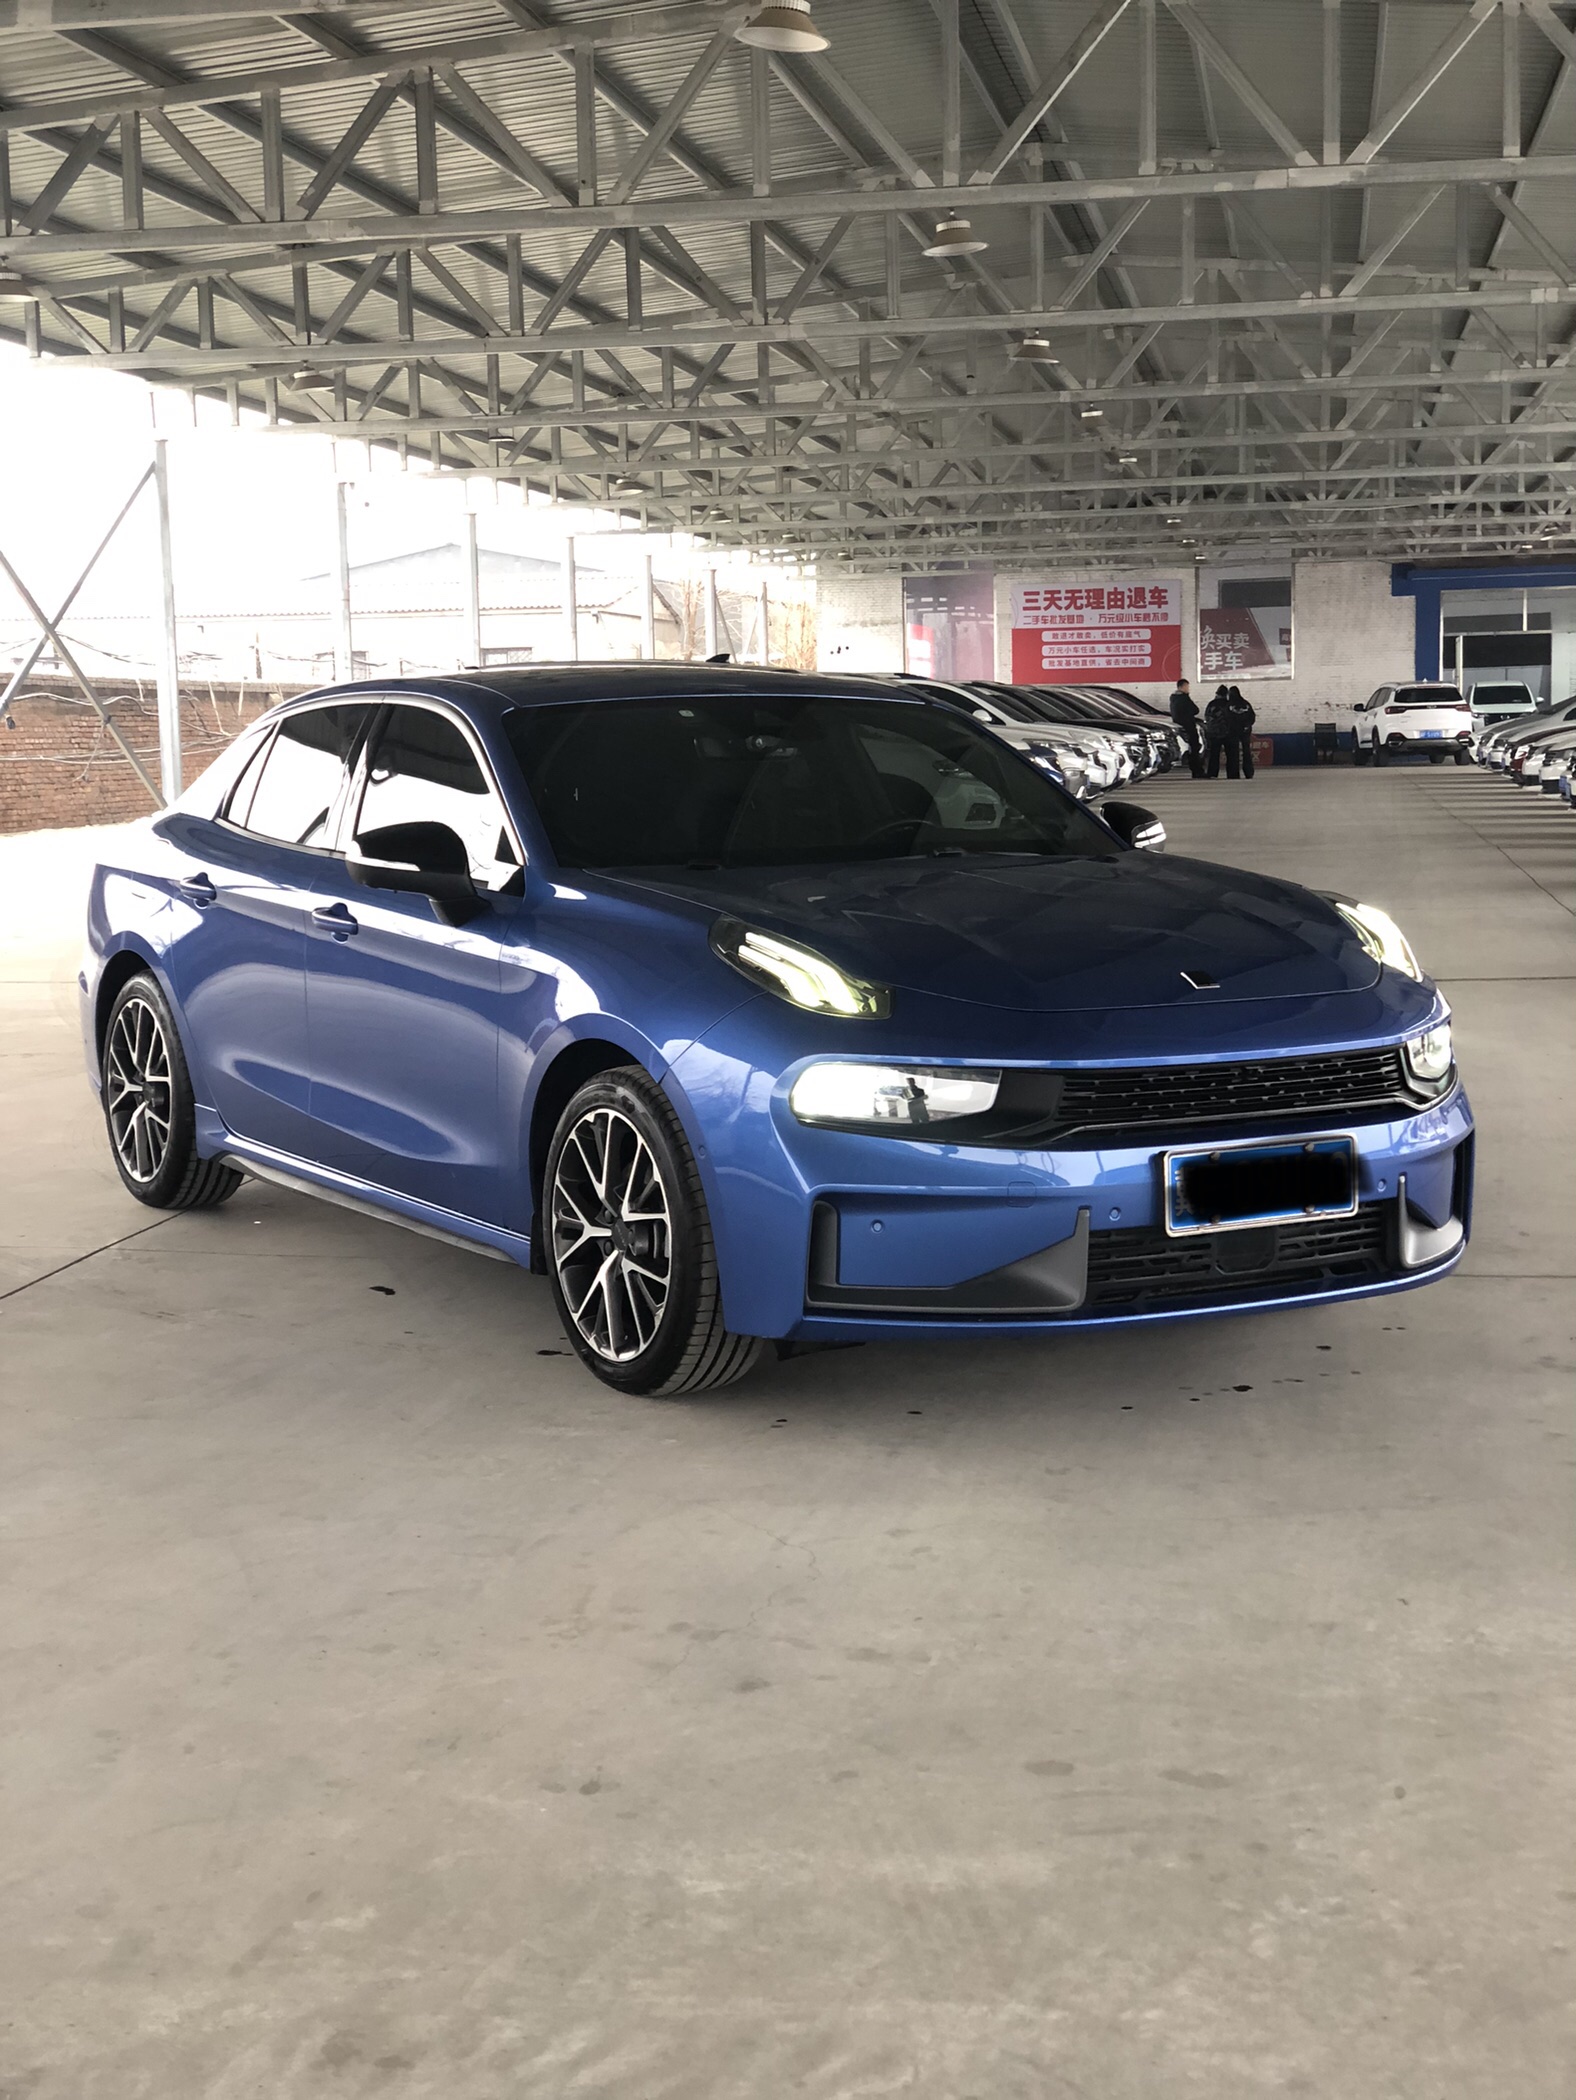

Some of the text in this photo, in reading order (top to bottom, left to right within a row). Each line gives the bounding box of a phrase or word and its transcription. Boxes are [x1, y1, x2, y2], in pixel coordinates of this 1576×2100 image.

[1022, 586, 1169, 611] 三天无理由退车
[1200, 651, 1244, 671] 手车
